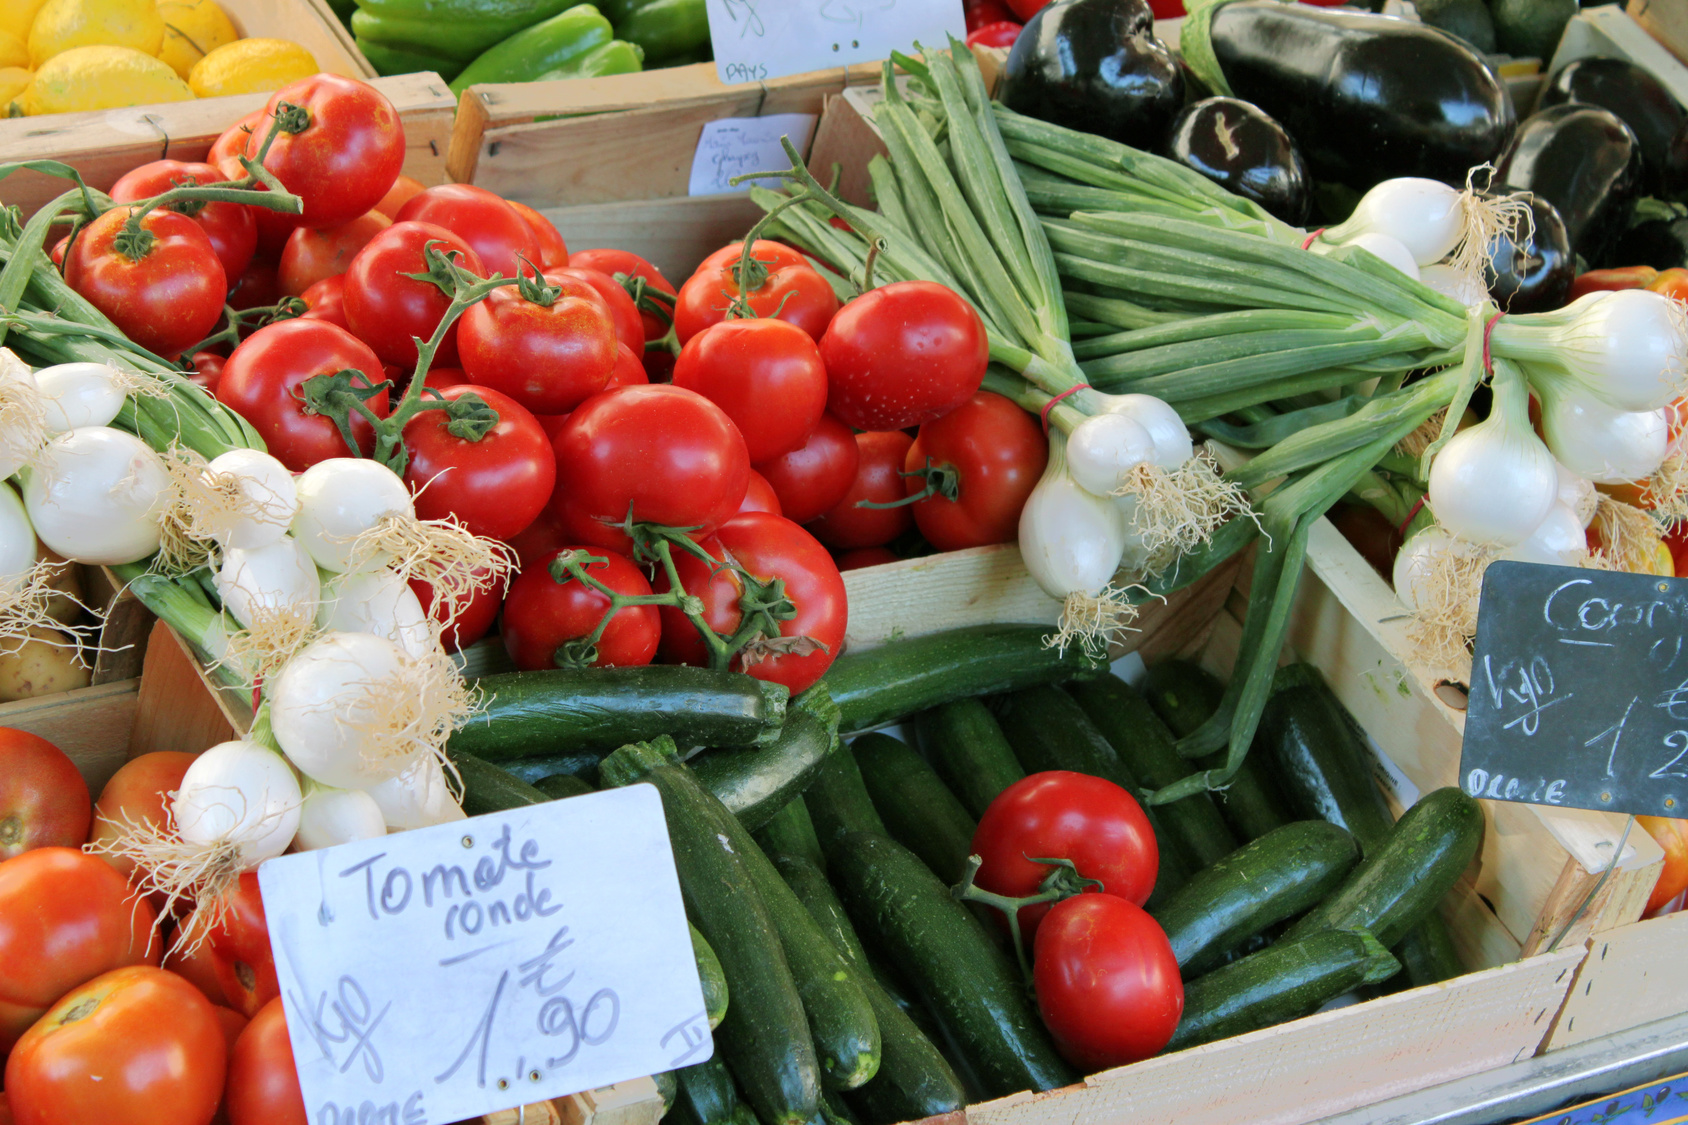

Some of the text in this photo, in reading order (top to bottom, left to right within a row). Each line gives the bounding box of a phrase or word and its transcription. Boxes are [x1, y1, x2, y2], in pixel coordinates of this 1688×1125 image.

[725, 62, 769, 82] PAYS
[338, 824, 553, 920] Tomate
[444, 871, 565, 940] ronde
